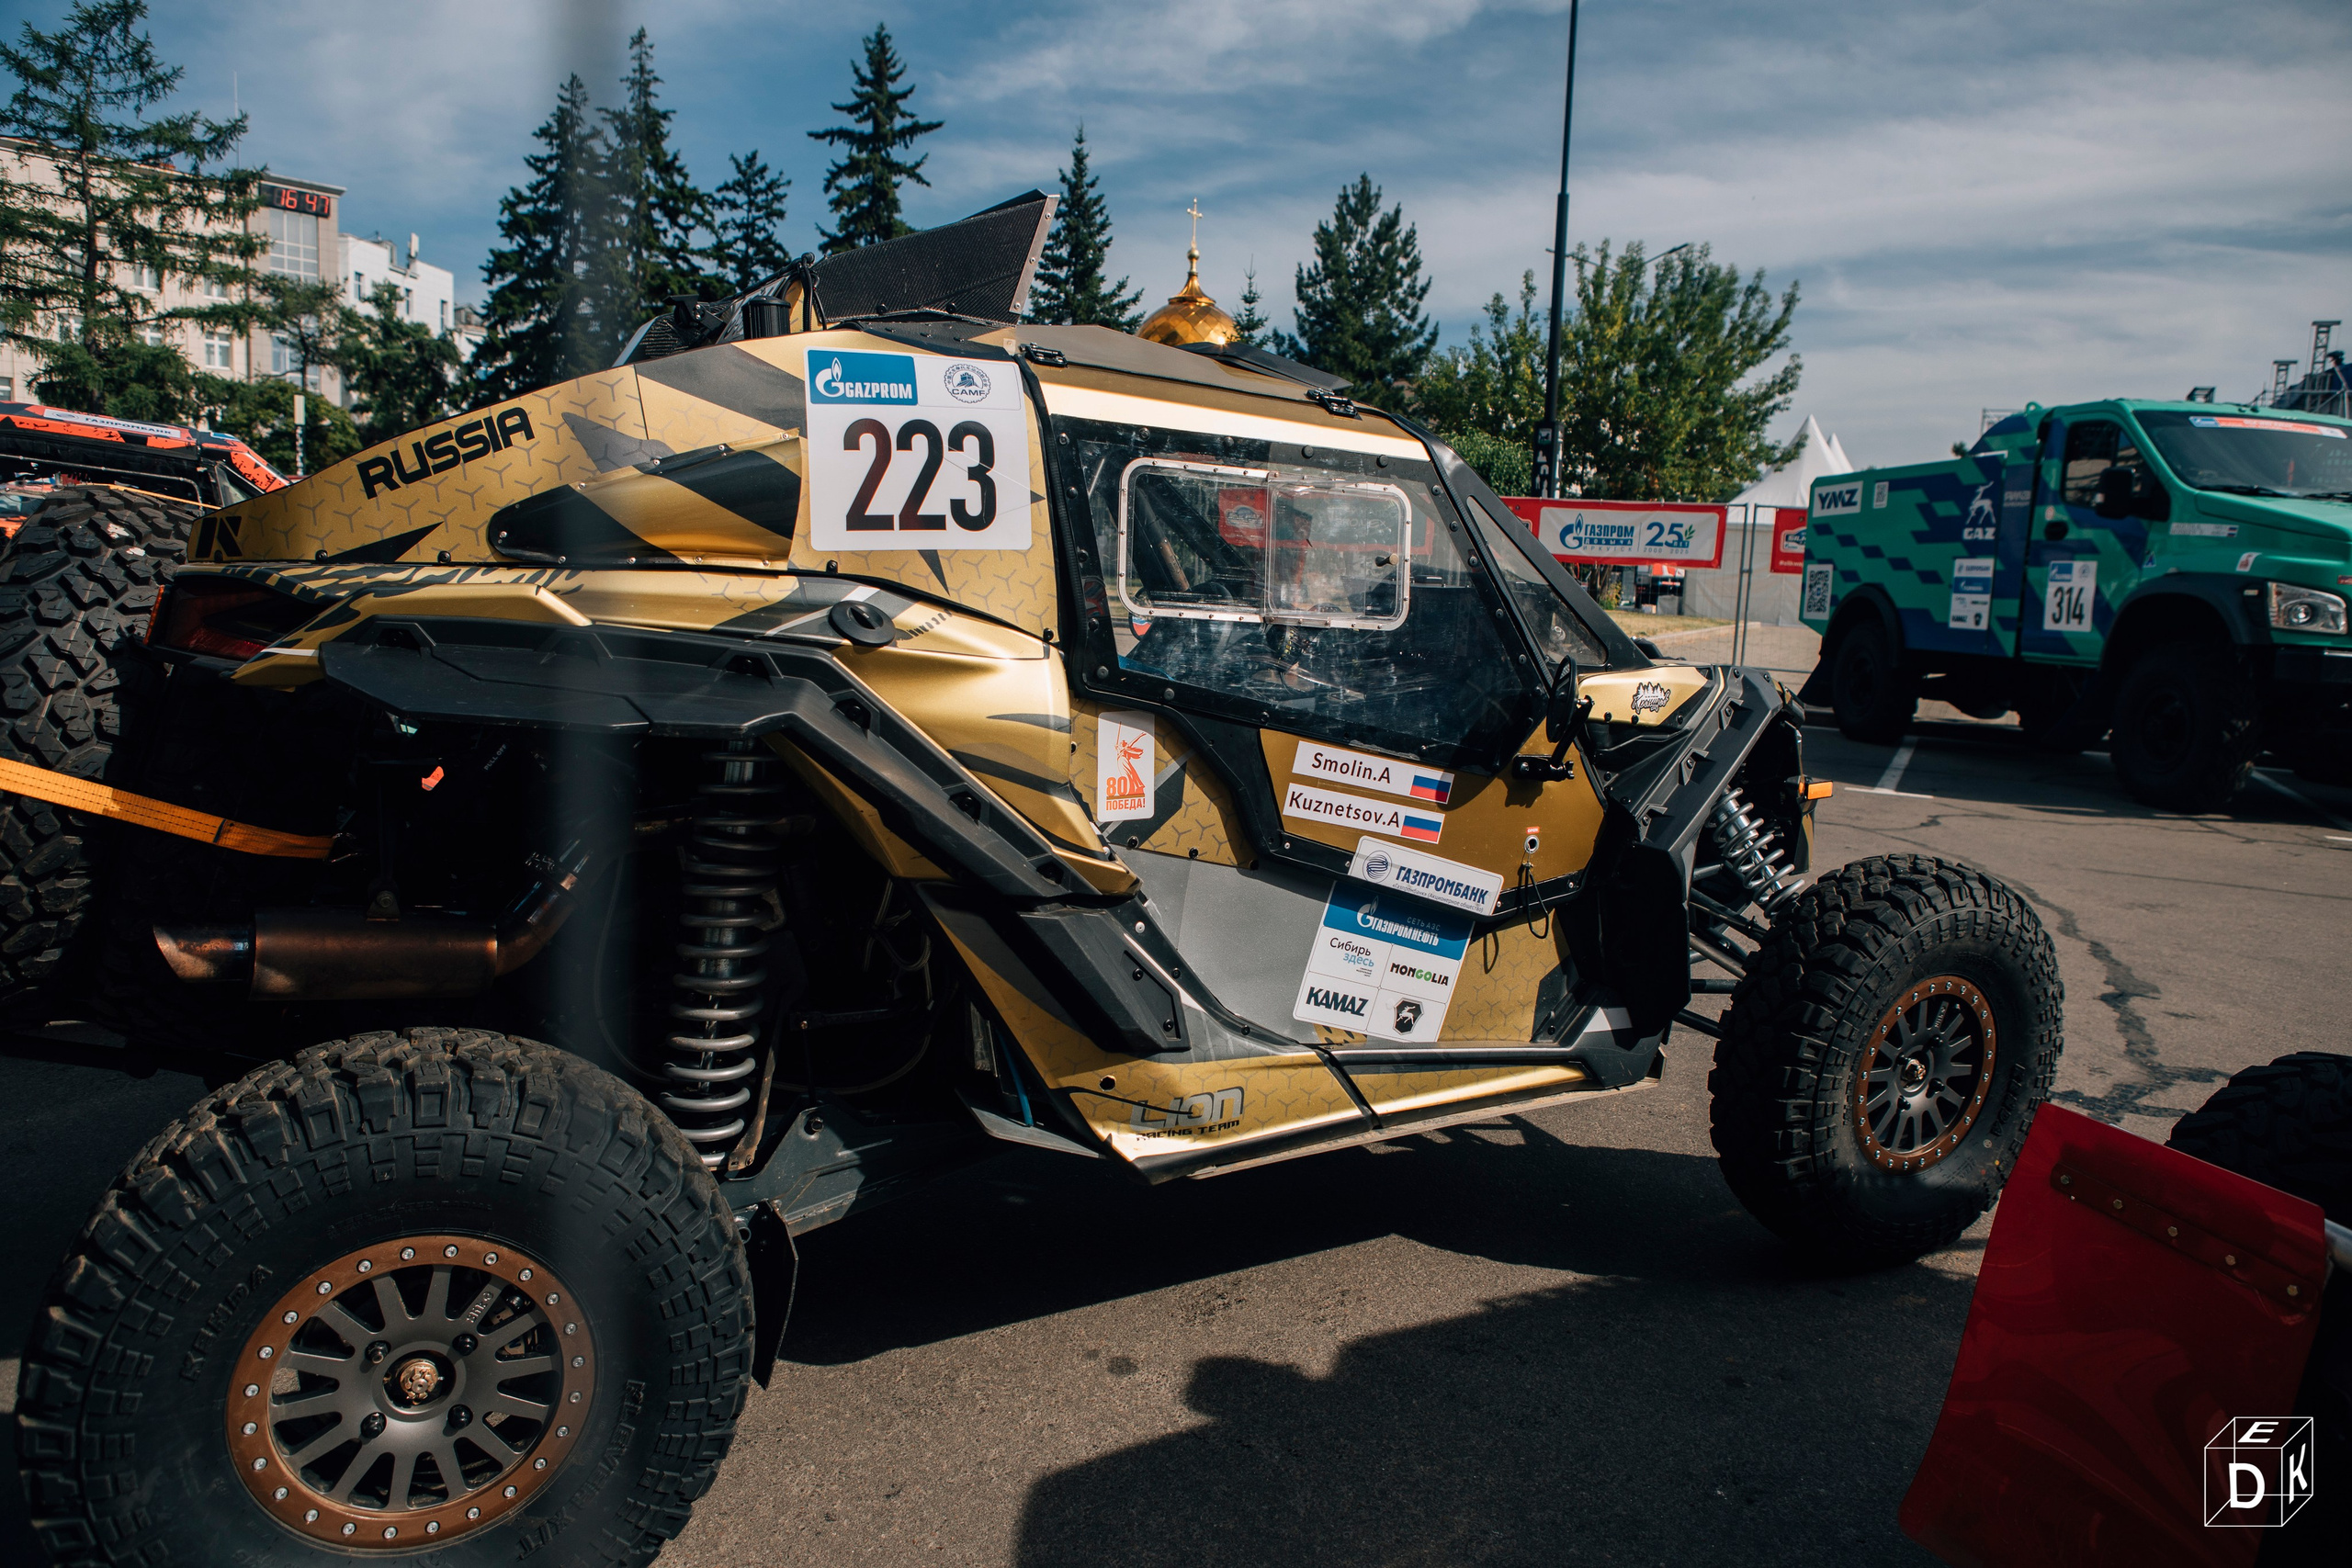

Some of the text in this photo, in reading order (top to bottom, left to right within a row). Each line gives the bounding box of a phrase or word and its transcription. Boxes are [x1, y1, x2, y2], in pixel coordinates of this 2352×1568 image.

[280, 189, 330, 214] 16 47
[844, 381, 913, 400] GAZPROM
[952, 389, 986, 397] CAMF
[85, 417, 173, 435] ГАЗПРОМБАНК
[356, 407, 536, 500] RUSSIA
[842, 418, 997, 532] 223
[1584, 524, 1635, 538] ГАЗПРОМ
[1645, 522, 1685, 548] 25
[1962, 527, 1996, 540] GAZ
[2052, 586, 2085, 626] 314
[1311, 752, 1391, 784] Smolin.A
[1106, 776, 1128, 797] 80
[1105, 798, 1146, 811] ПОБЕДА!
[1288, 791, 1399, 828] Kuznetsov.A
[1395, 865, 1489, 905] ГАЗПРОМБАНК
[1372, 919, 1440, 947] ГАЗПРОМНЕФТЬ
[1407, 916, 1442, 931] СЕТЬ АЗС
[1329, 937, 1372, 957] Сибирь
[1342, 953, 1374, 967] здесь
[1389, 963, 1450, 987] MONGOLIA
[1306, 986, 1369, 1017] KAMAZ
[1197, 1120, 1240, 1134] TEAM
